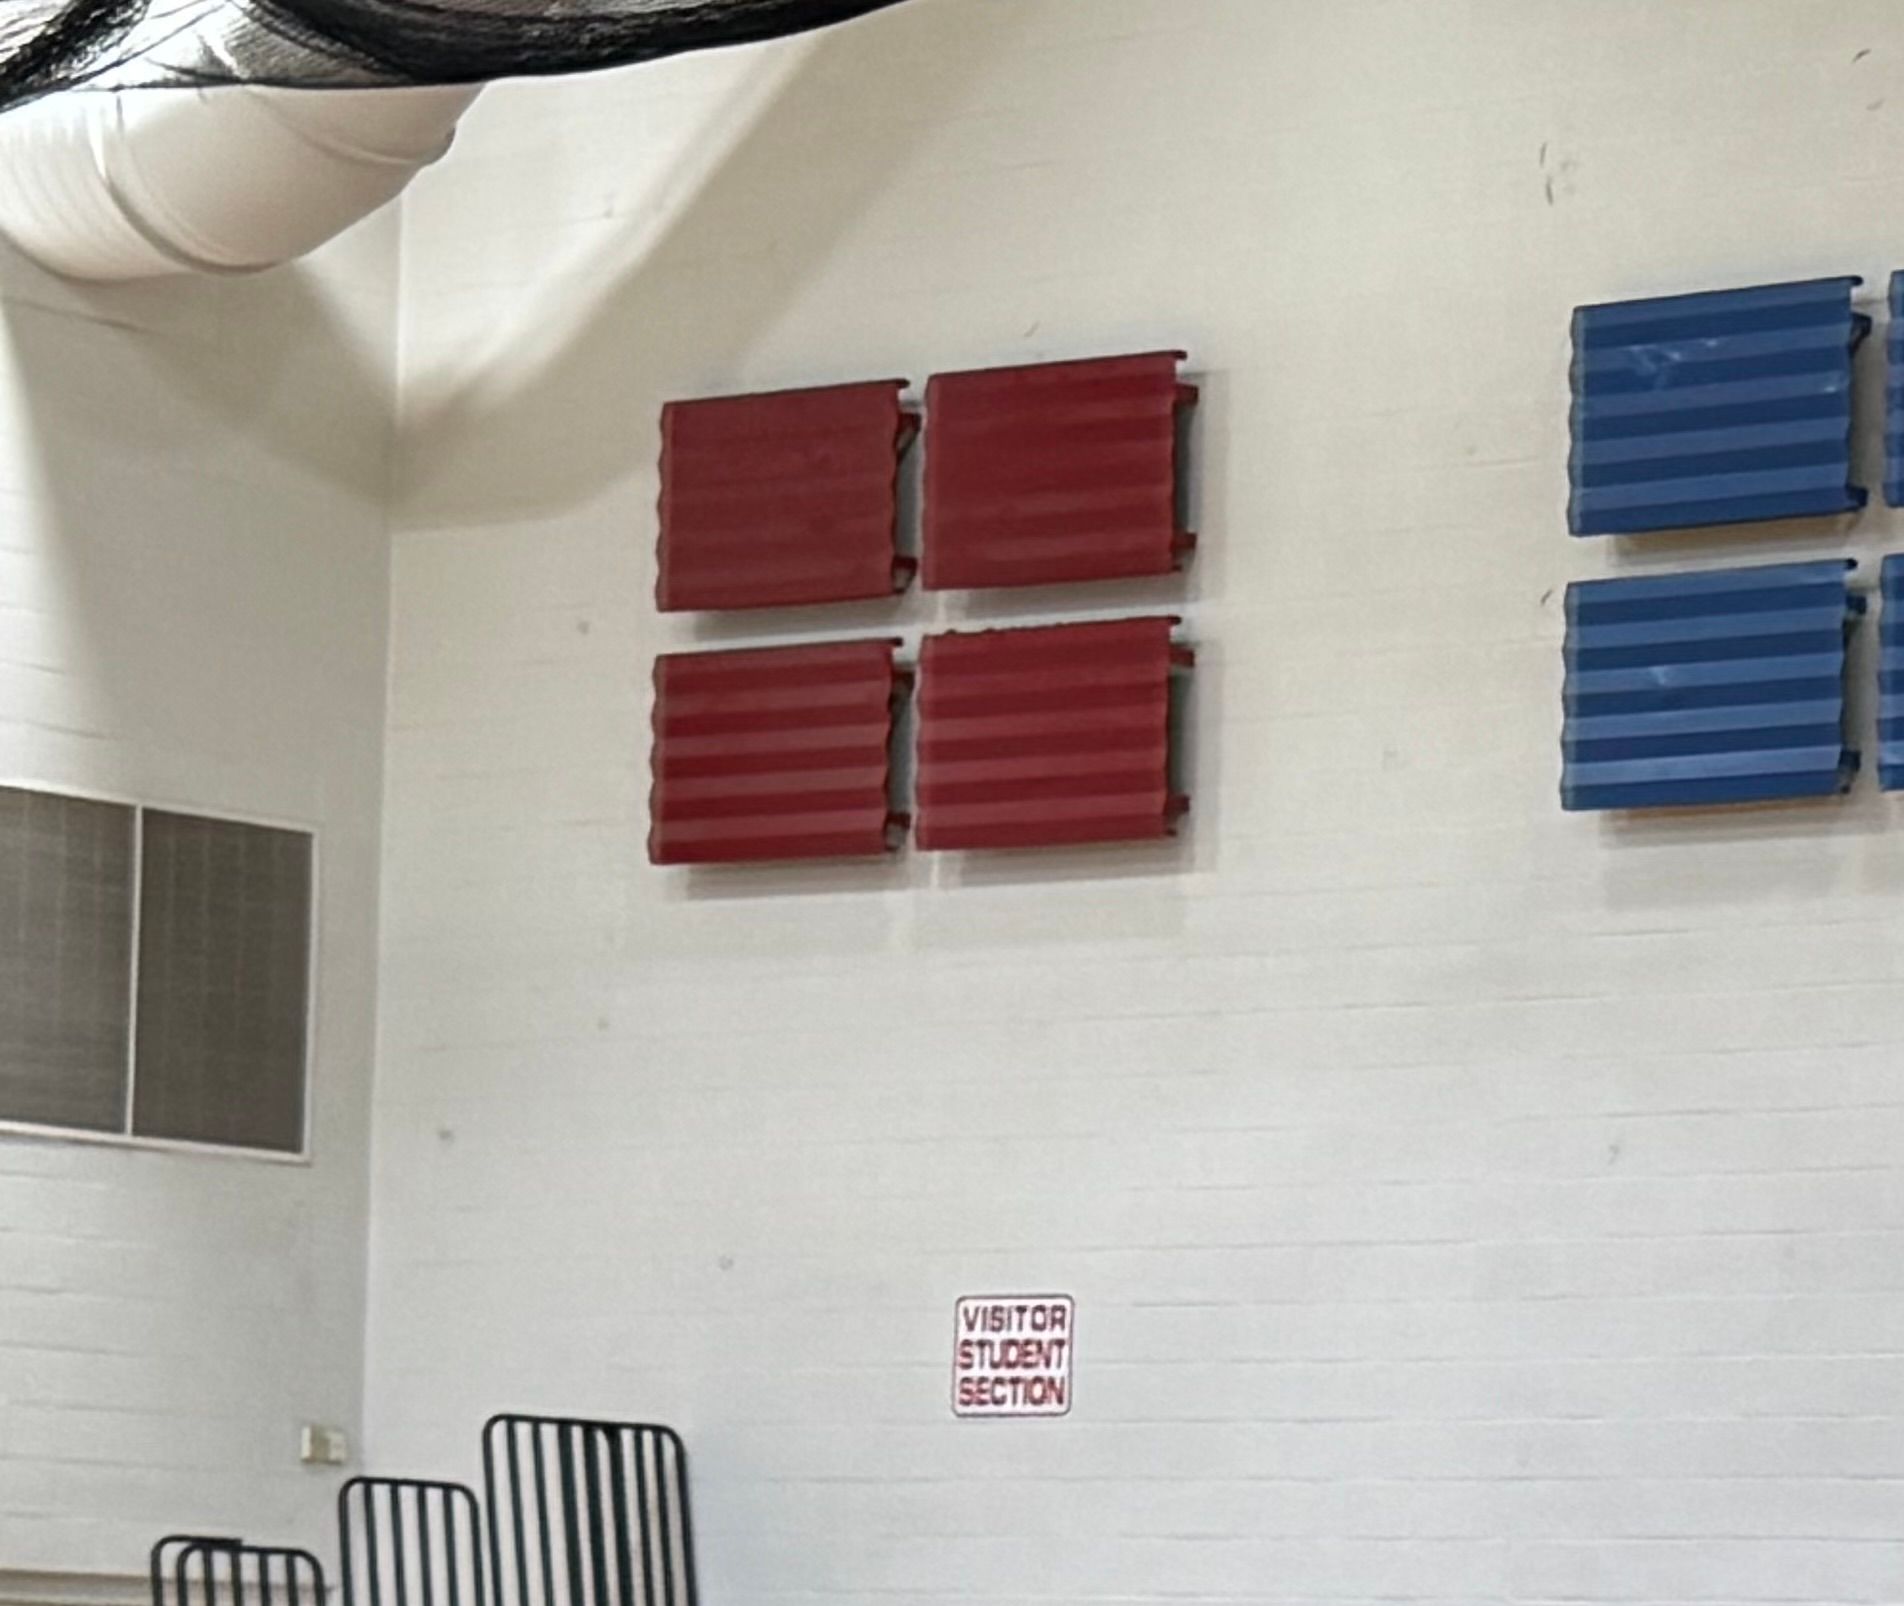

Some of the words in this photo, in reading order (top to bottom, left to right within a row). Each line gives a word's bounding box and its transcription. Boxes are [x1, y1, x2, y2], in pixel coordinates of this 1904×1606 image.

[963, 1304, 1067, 1332] VISITOR
[958, 1339, 1066, 1370] STUDENT
[958, 1376, 1065, 1407] SECTION
